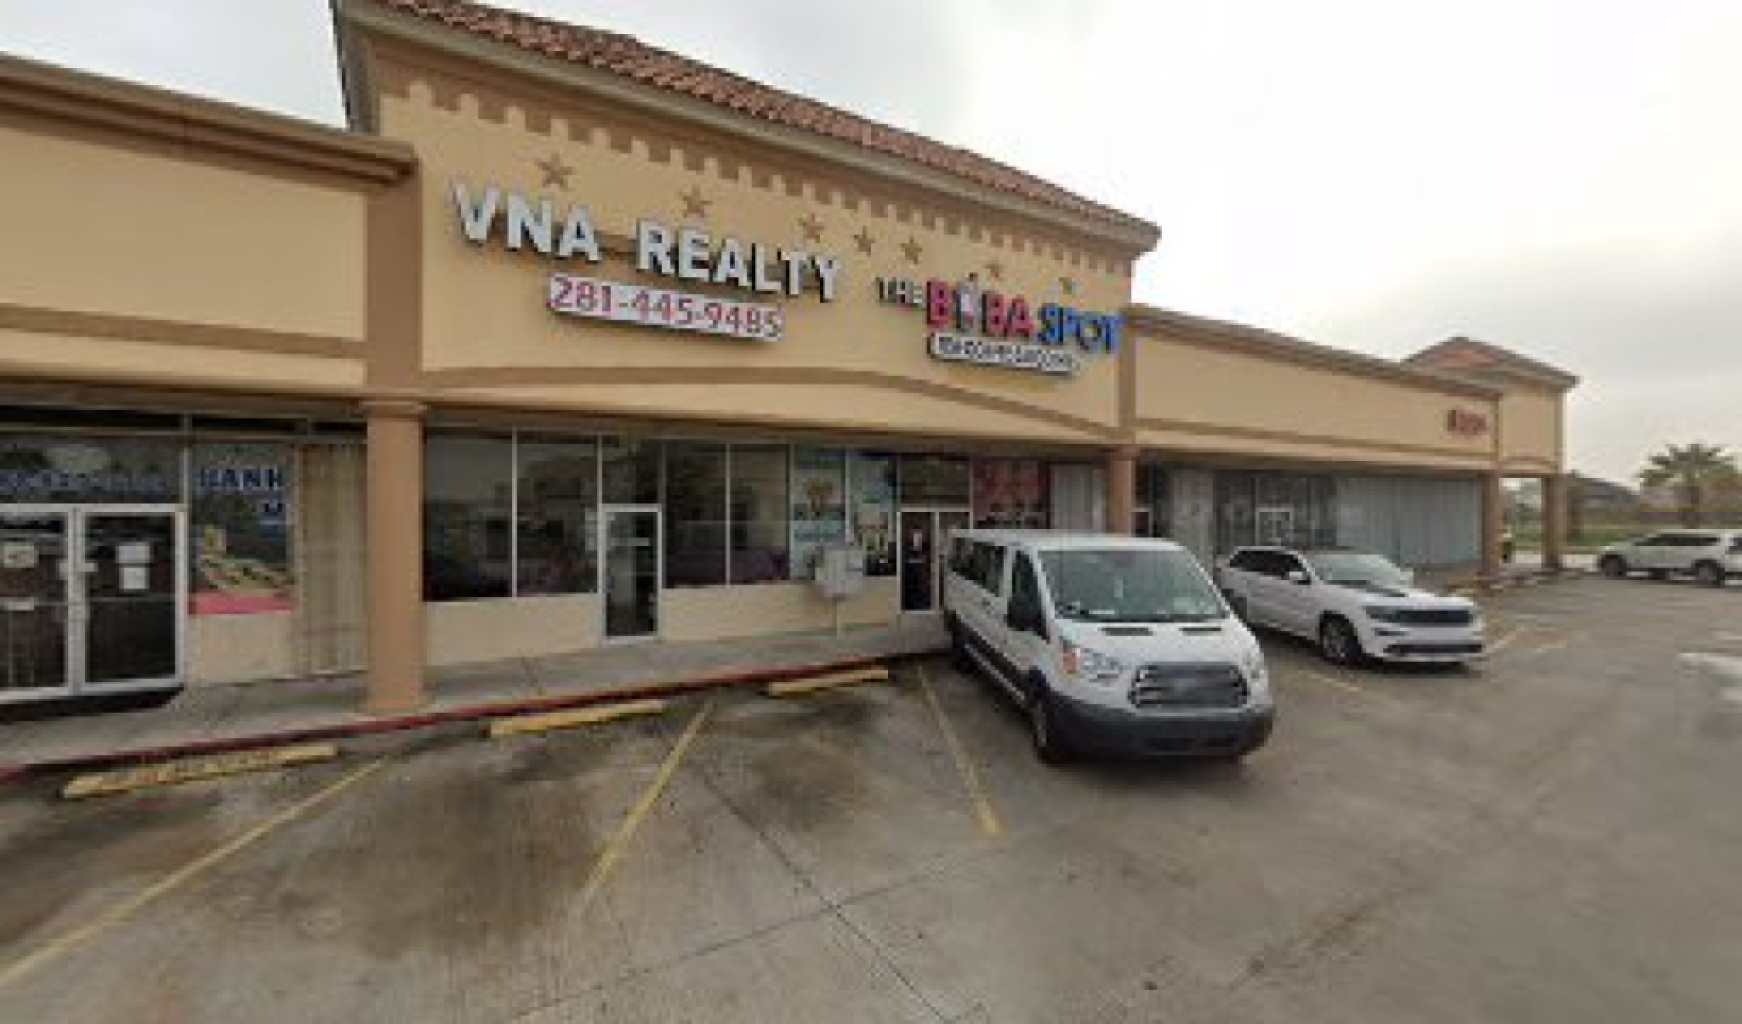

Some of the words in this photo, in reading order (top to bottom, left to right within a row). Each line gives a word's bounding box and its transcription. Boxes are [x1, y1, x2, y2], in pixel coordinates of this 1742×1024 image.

[452, 182, 600, 262] VNA
[636, 217, 841, 302] REALTY
[550, 275, 783, 338] 281-445-9485
[875, 276, 923, 307] THE
[1036, 303, 1122, 354] SPOT
